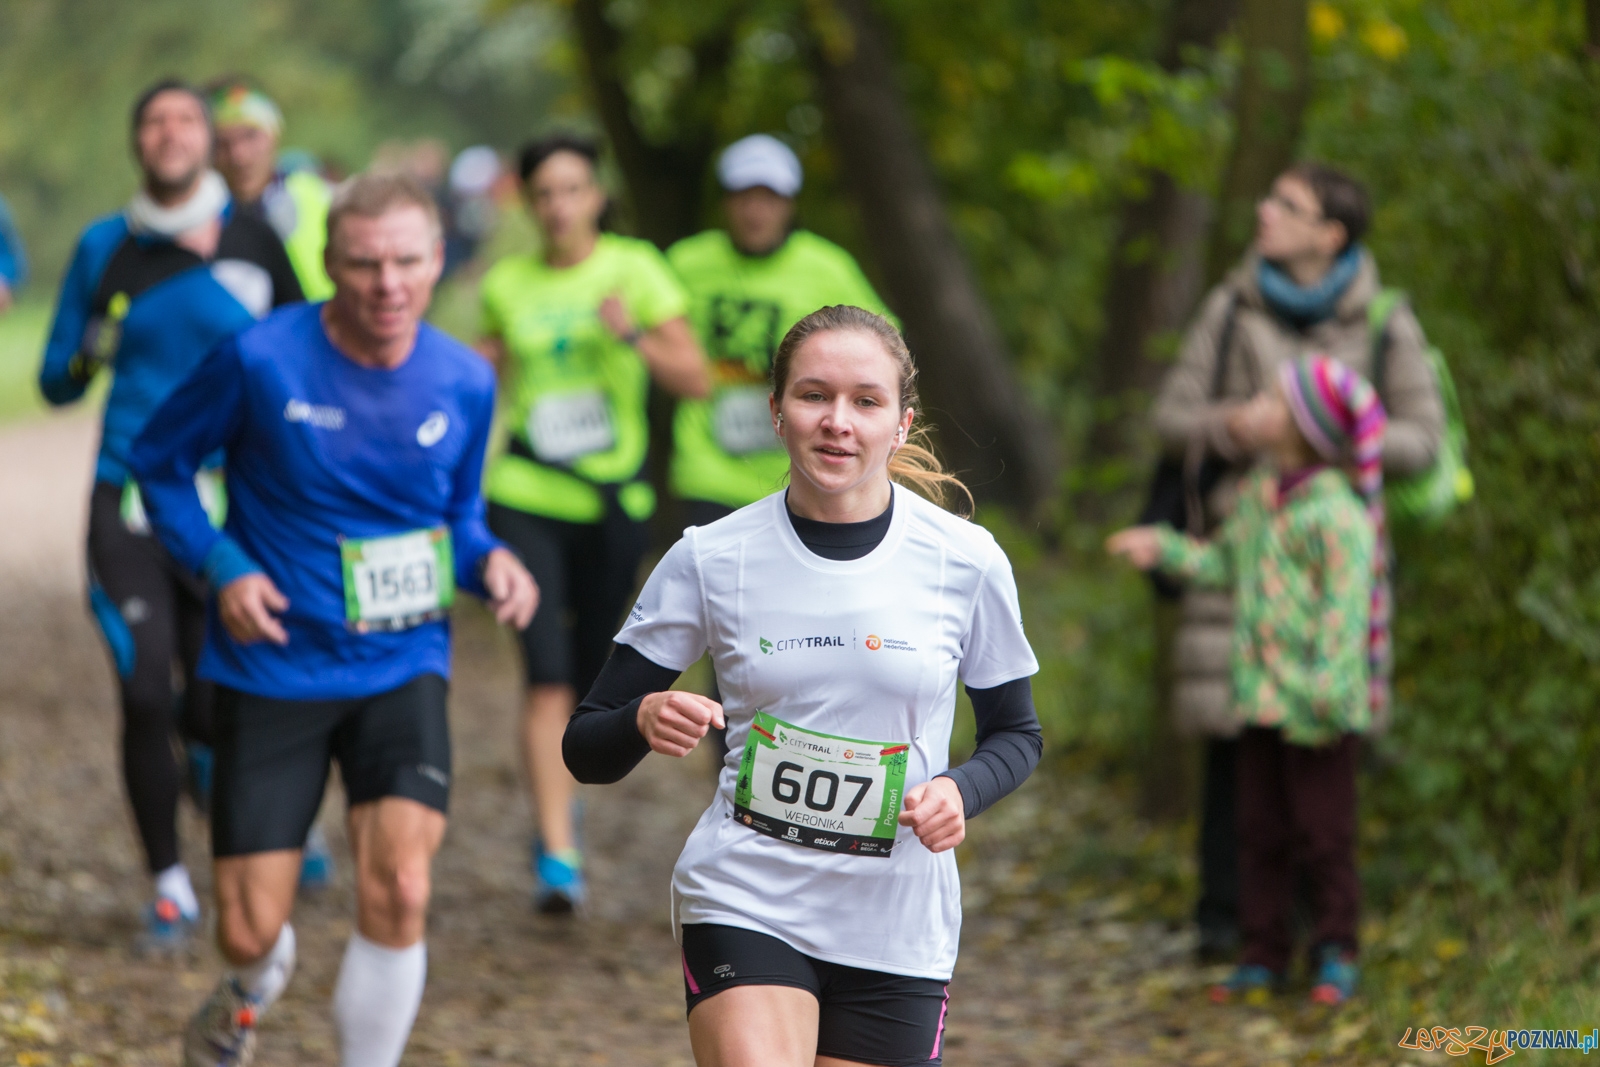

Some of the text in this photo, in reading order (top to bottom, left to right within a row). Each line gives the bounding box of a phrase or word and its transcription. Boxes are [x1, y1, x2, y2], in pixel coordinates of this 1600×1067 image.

[367, 560, 433, 602] 1563
[884, 644, 917, 652] nederlanden
[772, 760, 873, 817] 607
[785, 809, 845, 831] WERONIKA
